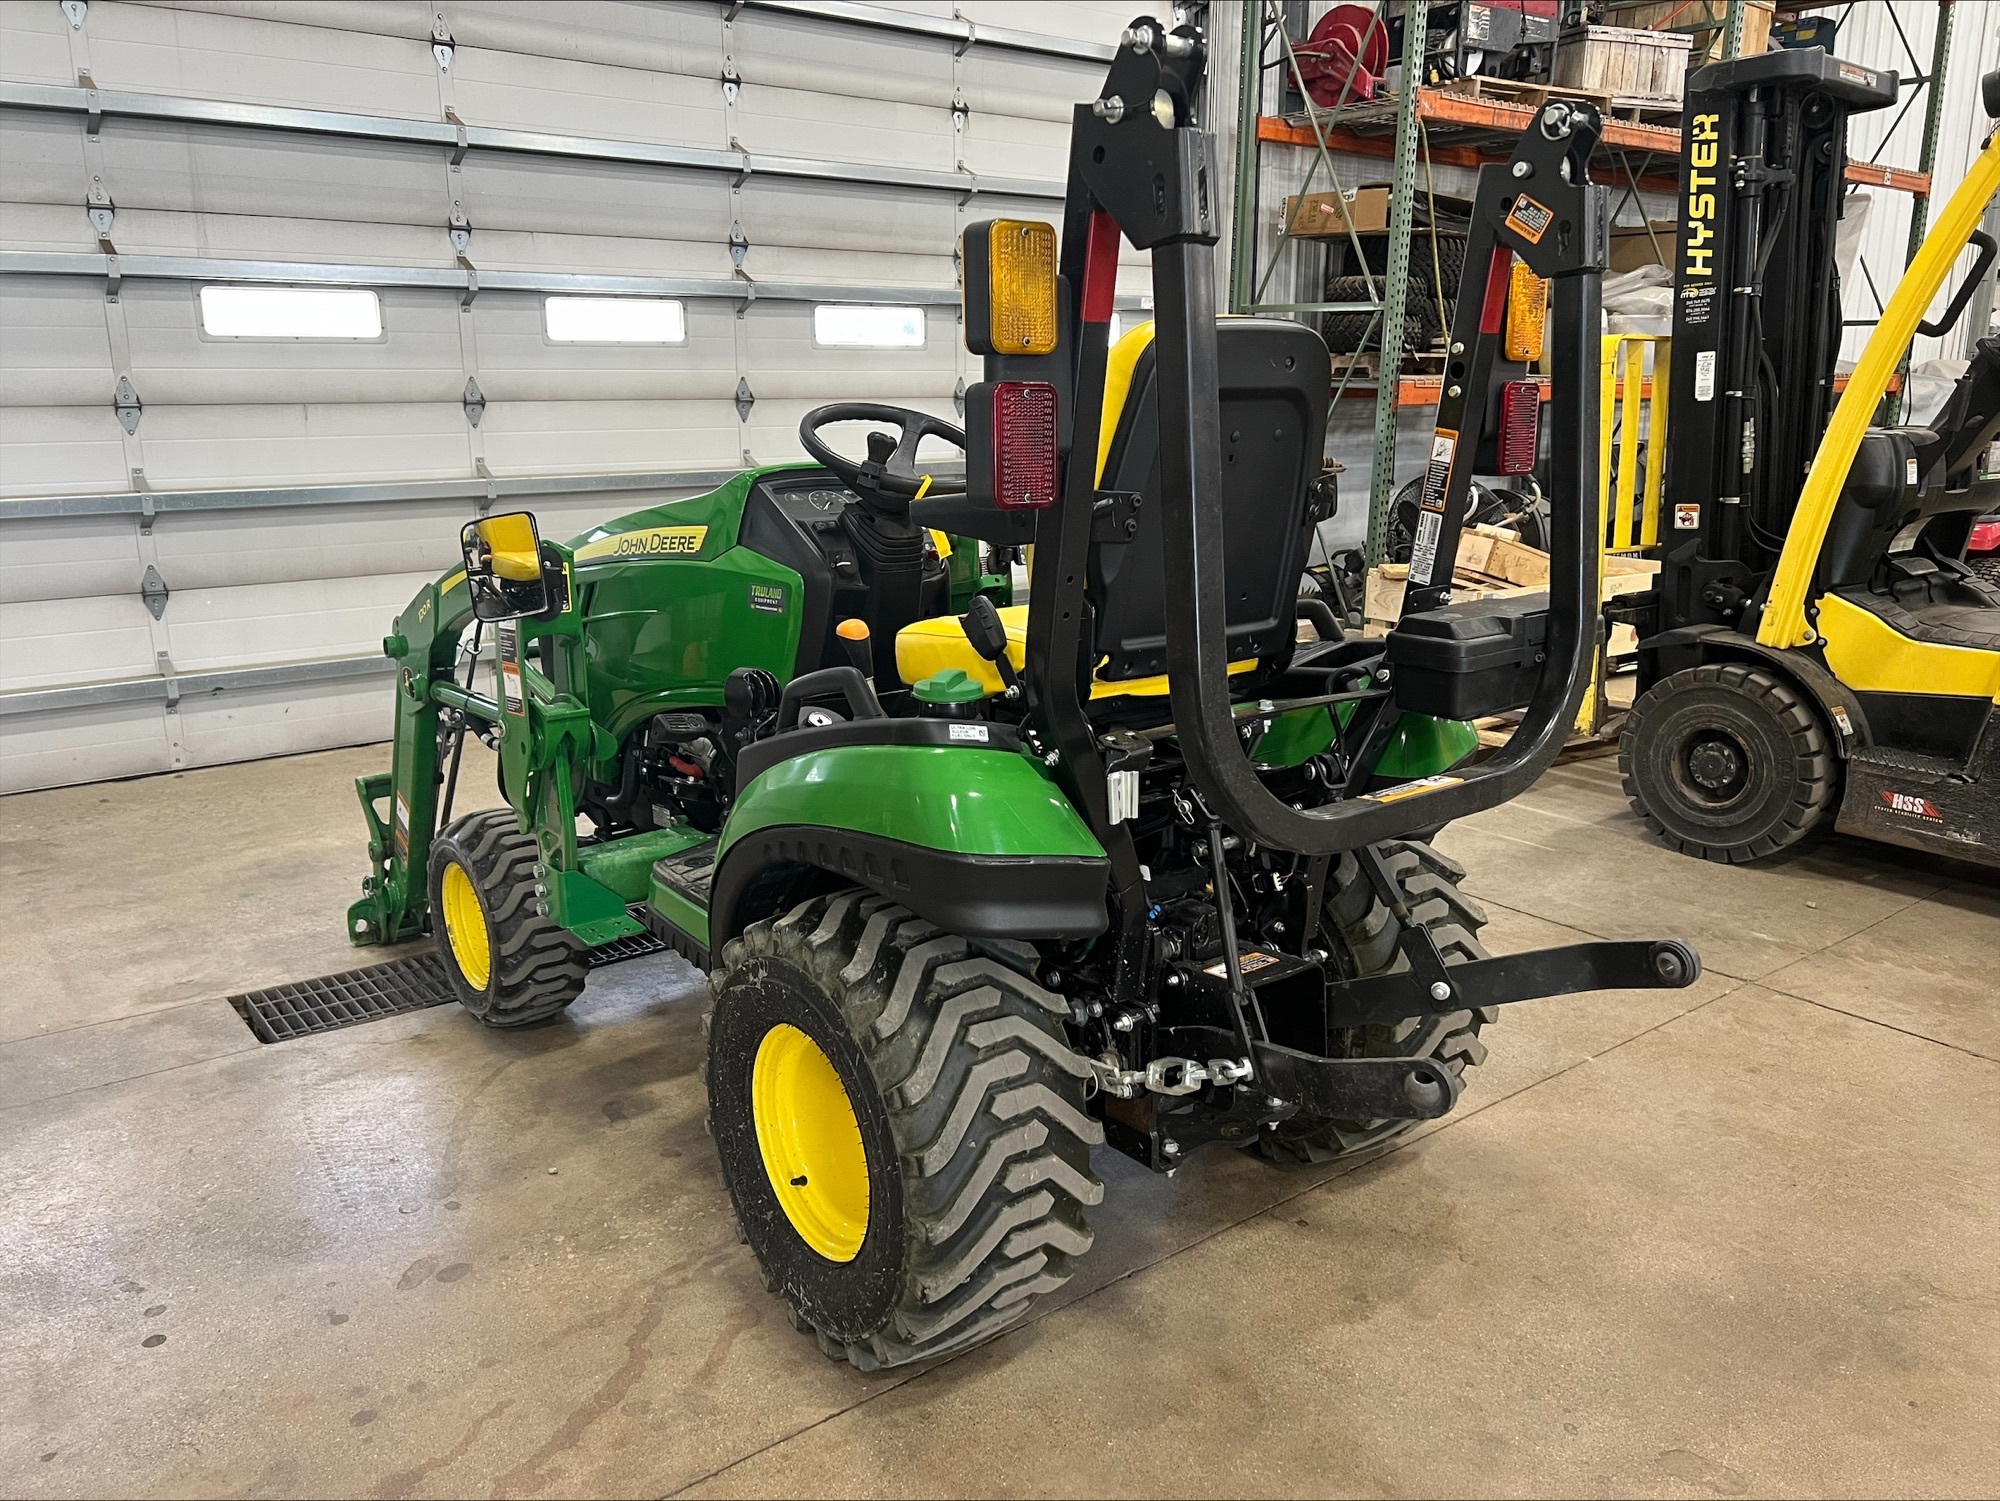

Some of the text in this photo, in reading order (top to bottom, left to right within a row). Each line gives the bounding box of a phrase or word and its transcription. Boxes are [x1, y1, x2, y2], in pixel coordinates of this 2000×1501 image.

[1686, 114, 1719, 275] HYSTER
[613, 533, 697, 555] JOHN DEERE
[751, 585, 782, 599] TRULAND
[1892, 793, 1925, 814] HSS
